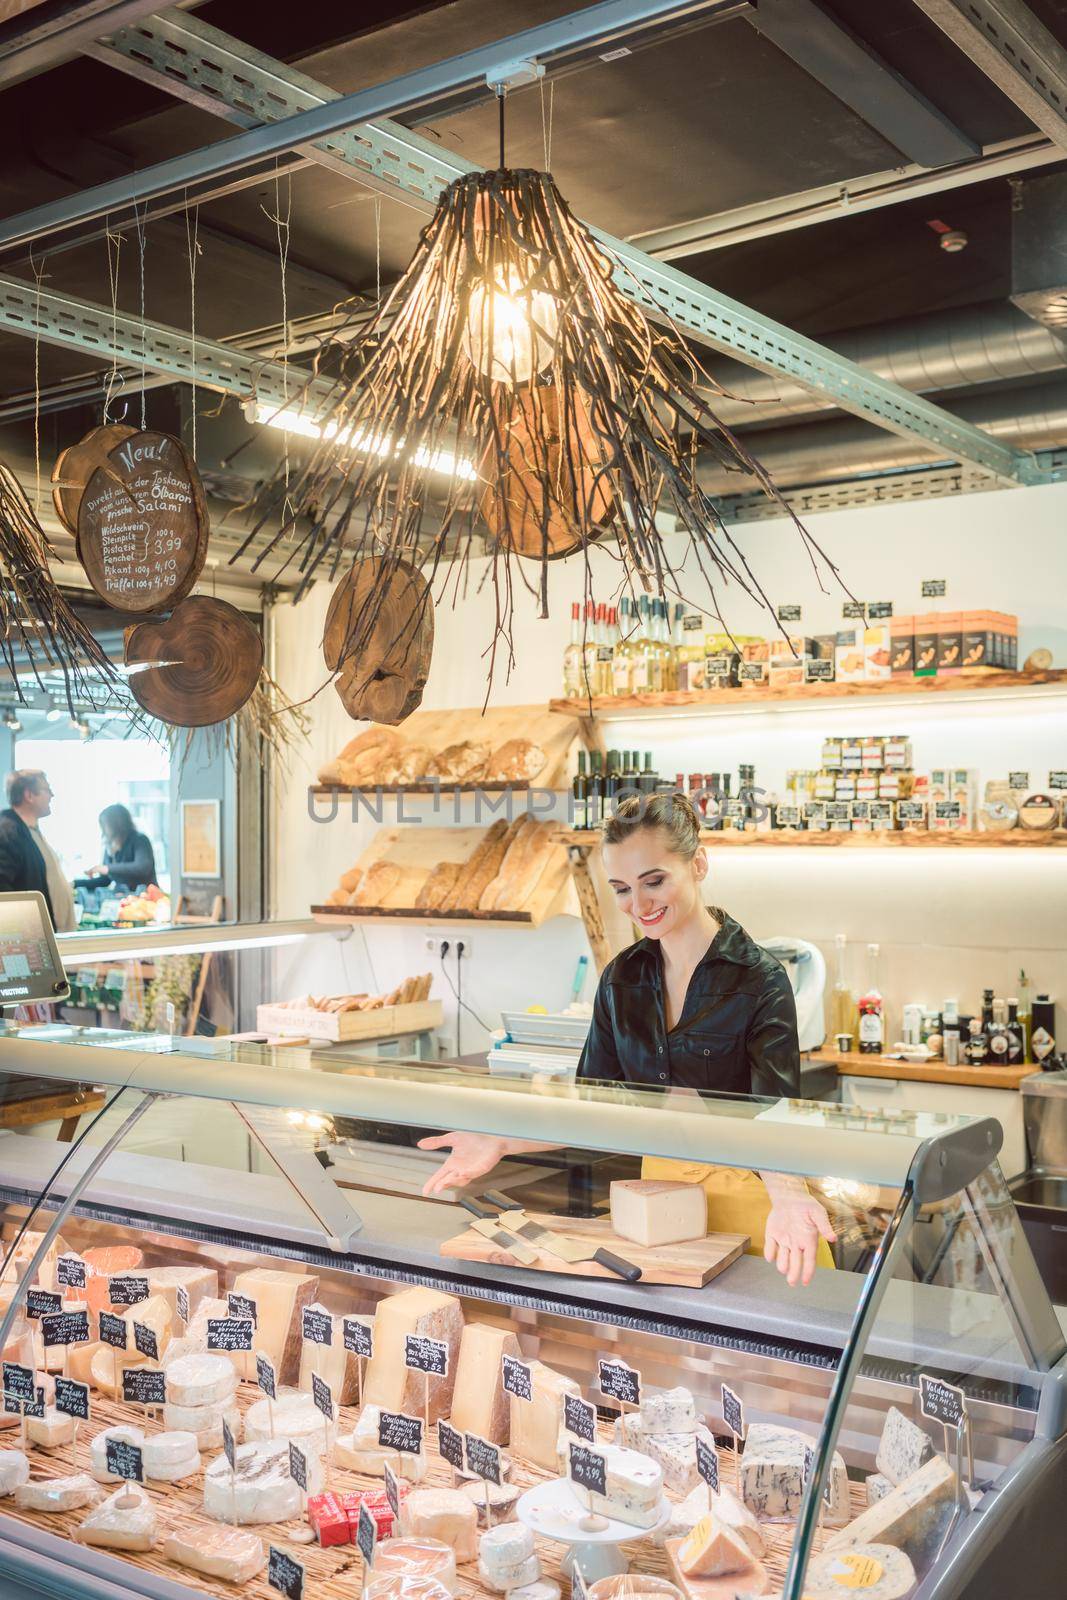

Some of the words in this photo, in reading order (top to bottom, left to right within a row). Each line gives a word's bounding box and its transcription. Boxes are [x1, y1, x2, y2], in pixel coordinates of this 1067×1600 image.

[120, 439, 168, 472] Neu!
[87, 488, 112, 511] Direkt
[135, 477, 150, 487] der
[100, 502, 113, 514] vom
[138, 500, 181, 513] Salami
[101, 521, 144, 536] Wildschwein
[102, 533, 136, 546] Steinpilz
[103, 544, 136, 555] Pistazie
[154, 537, 181, 555] 3,99
[104, 552, 135, 564] Fenchel
[105, 564, 131, 575] Pikant
[155, 560, 176, 573] 4,10
[105, 577, 135, 592] Trüffel
[155, 574, 177, 588] 4,49
